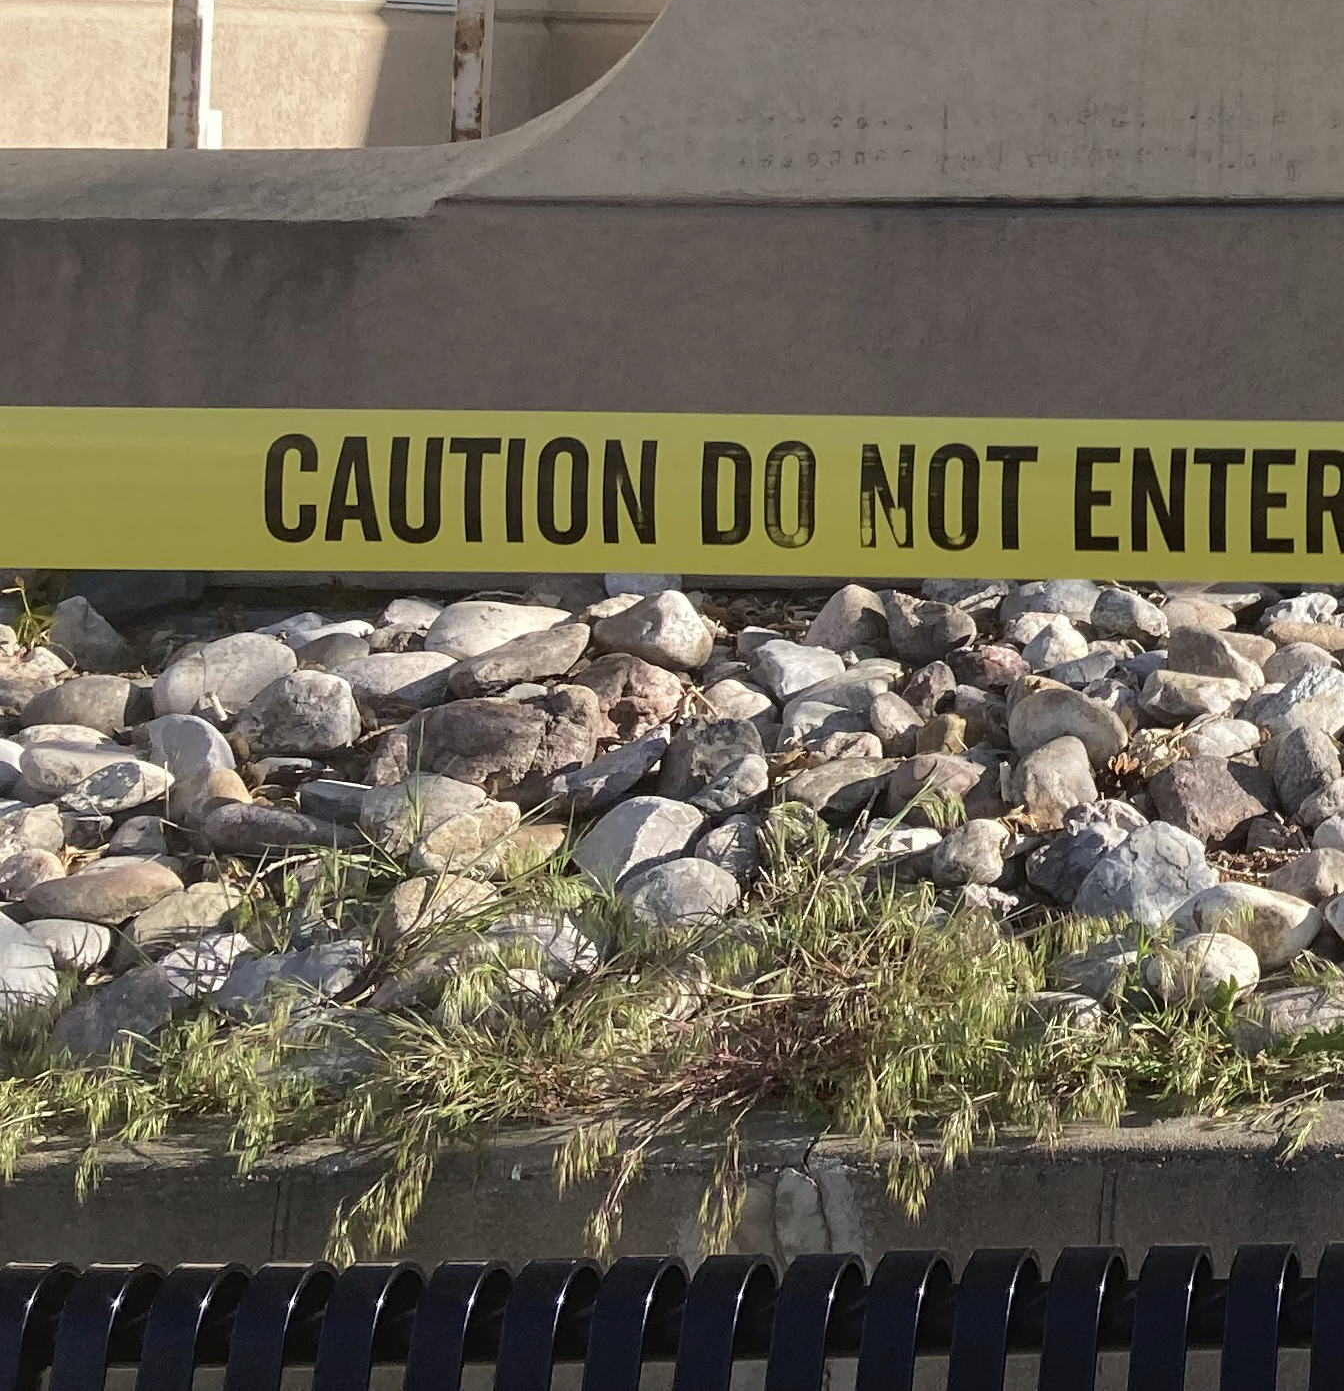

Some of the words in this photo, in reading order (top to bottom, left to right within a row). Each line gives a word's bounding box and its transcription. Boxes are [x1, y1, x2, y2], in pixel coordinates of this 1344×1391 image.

[264, 433, 658, 545] CAUTION
[700, 441, 817, 549] DO
[859, 442, 1039, 551] NOT
